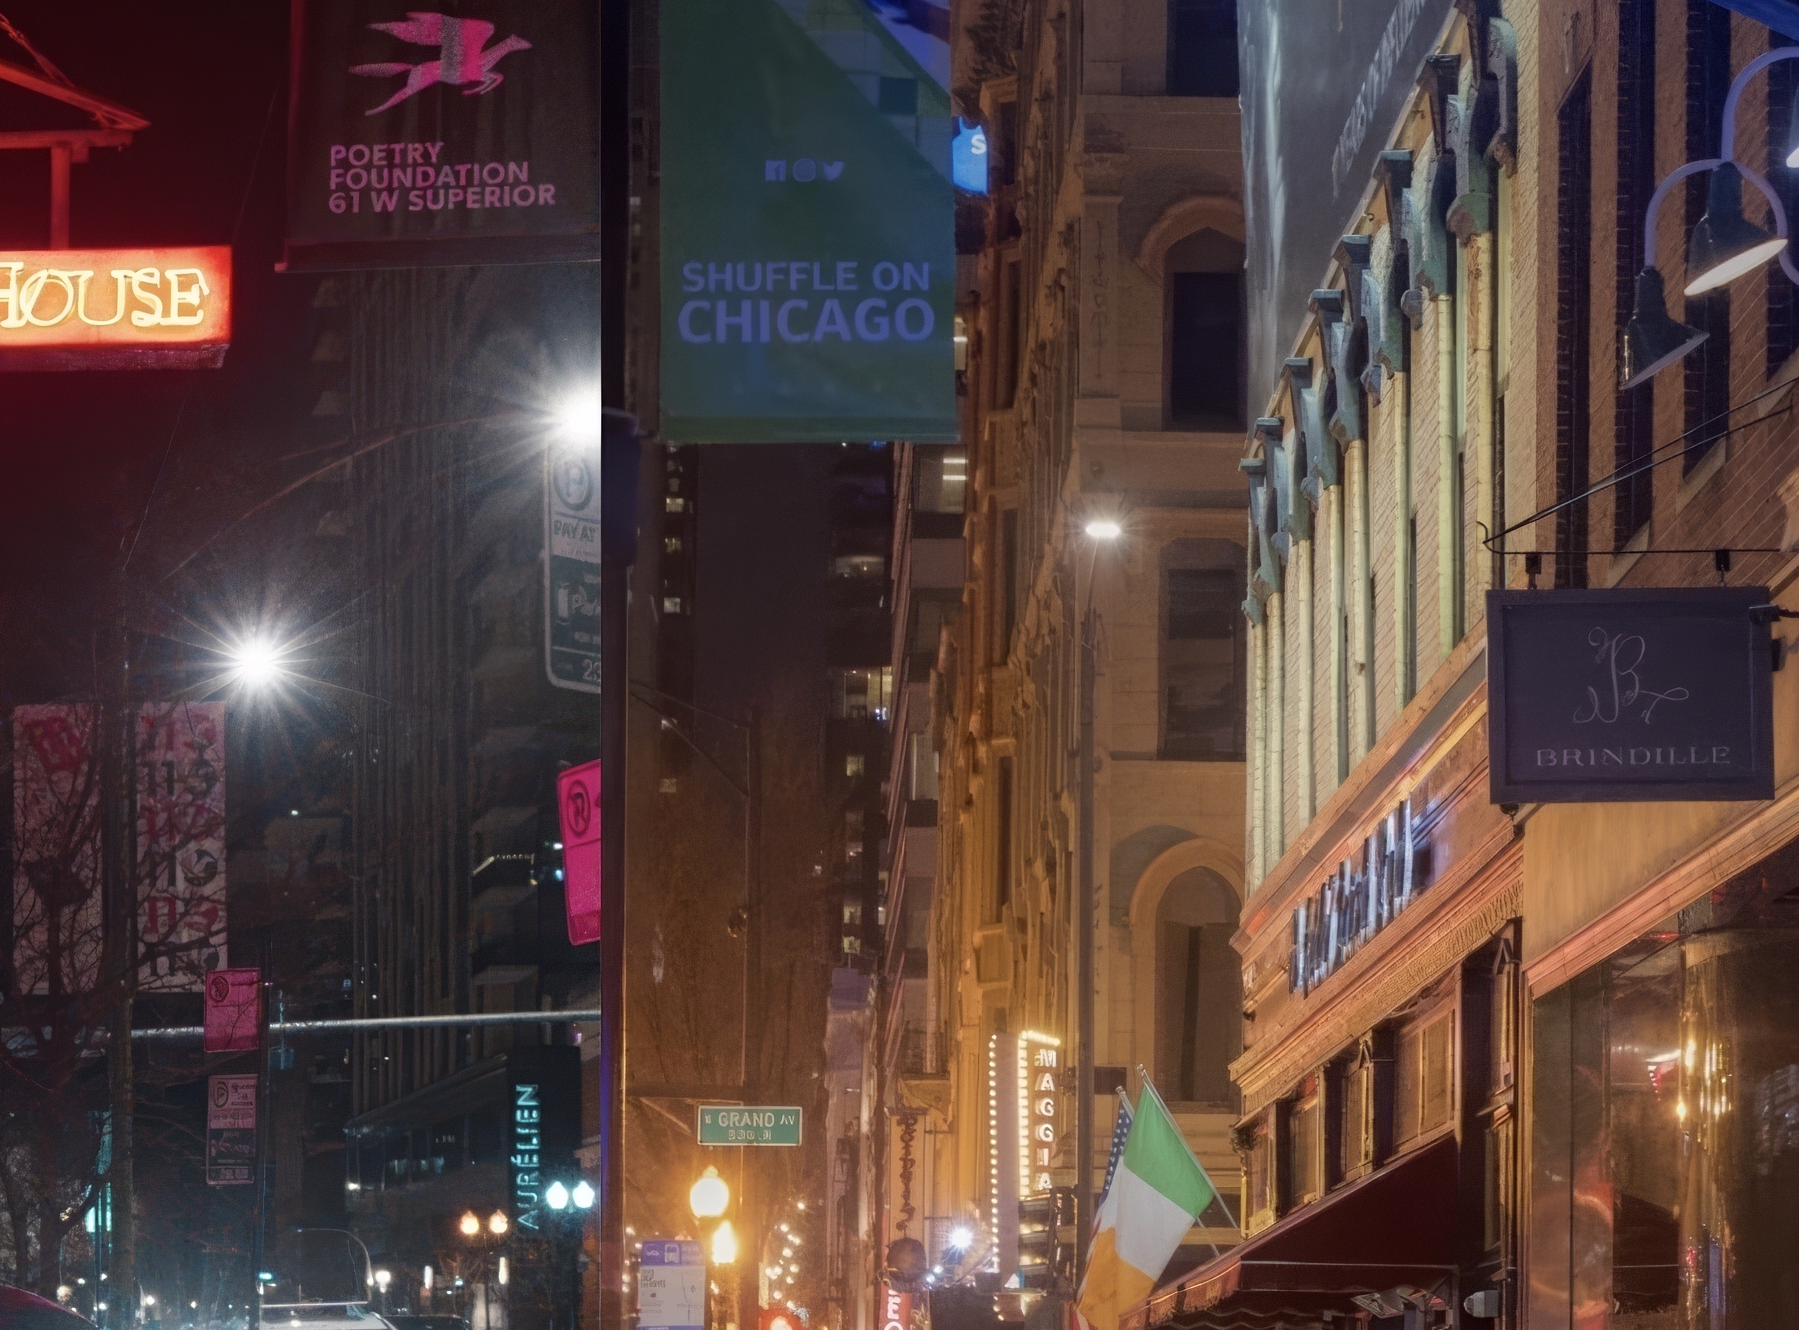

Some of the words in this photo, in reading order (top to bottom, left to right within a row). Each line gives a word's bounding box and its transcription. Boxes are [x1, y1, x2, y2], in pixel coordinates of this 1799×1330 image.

[330, 142, 444, 167] POETRY
[329, 161, 528, 190] FOUNDATION
[328, 191, 360, 214] 61
[371, 189, 399, 212] W
[408, 183, 556, 211] SUPERIOR
[681, 259, 858, 292] SHUFFLE
[872, 261, 929, 291] ON
[678, 297, 935, 344] CHICAGO
[1537, 746, 1731, 767] BRINDILLE
[718, 1111, 775, 1127] GRAND
